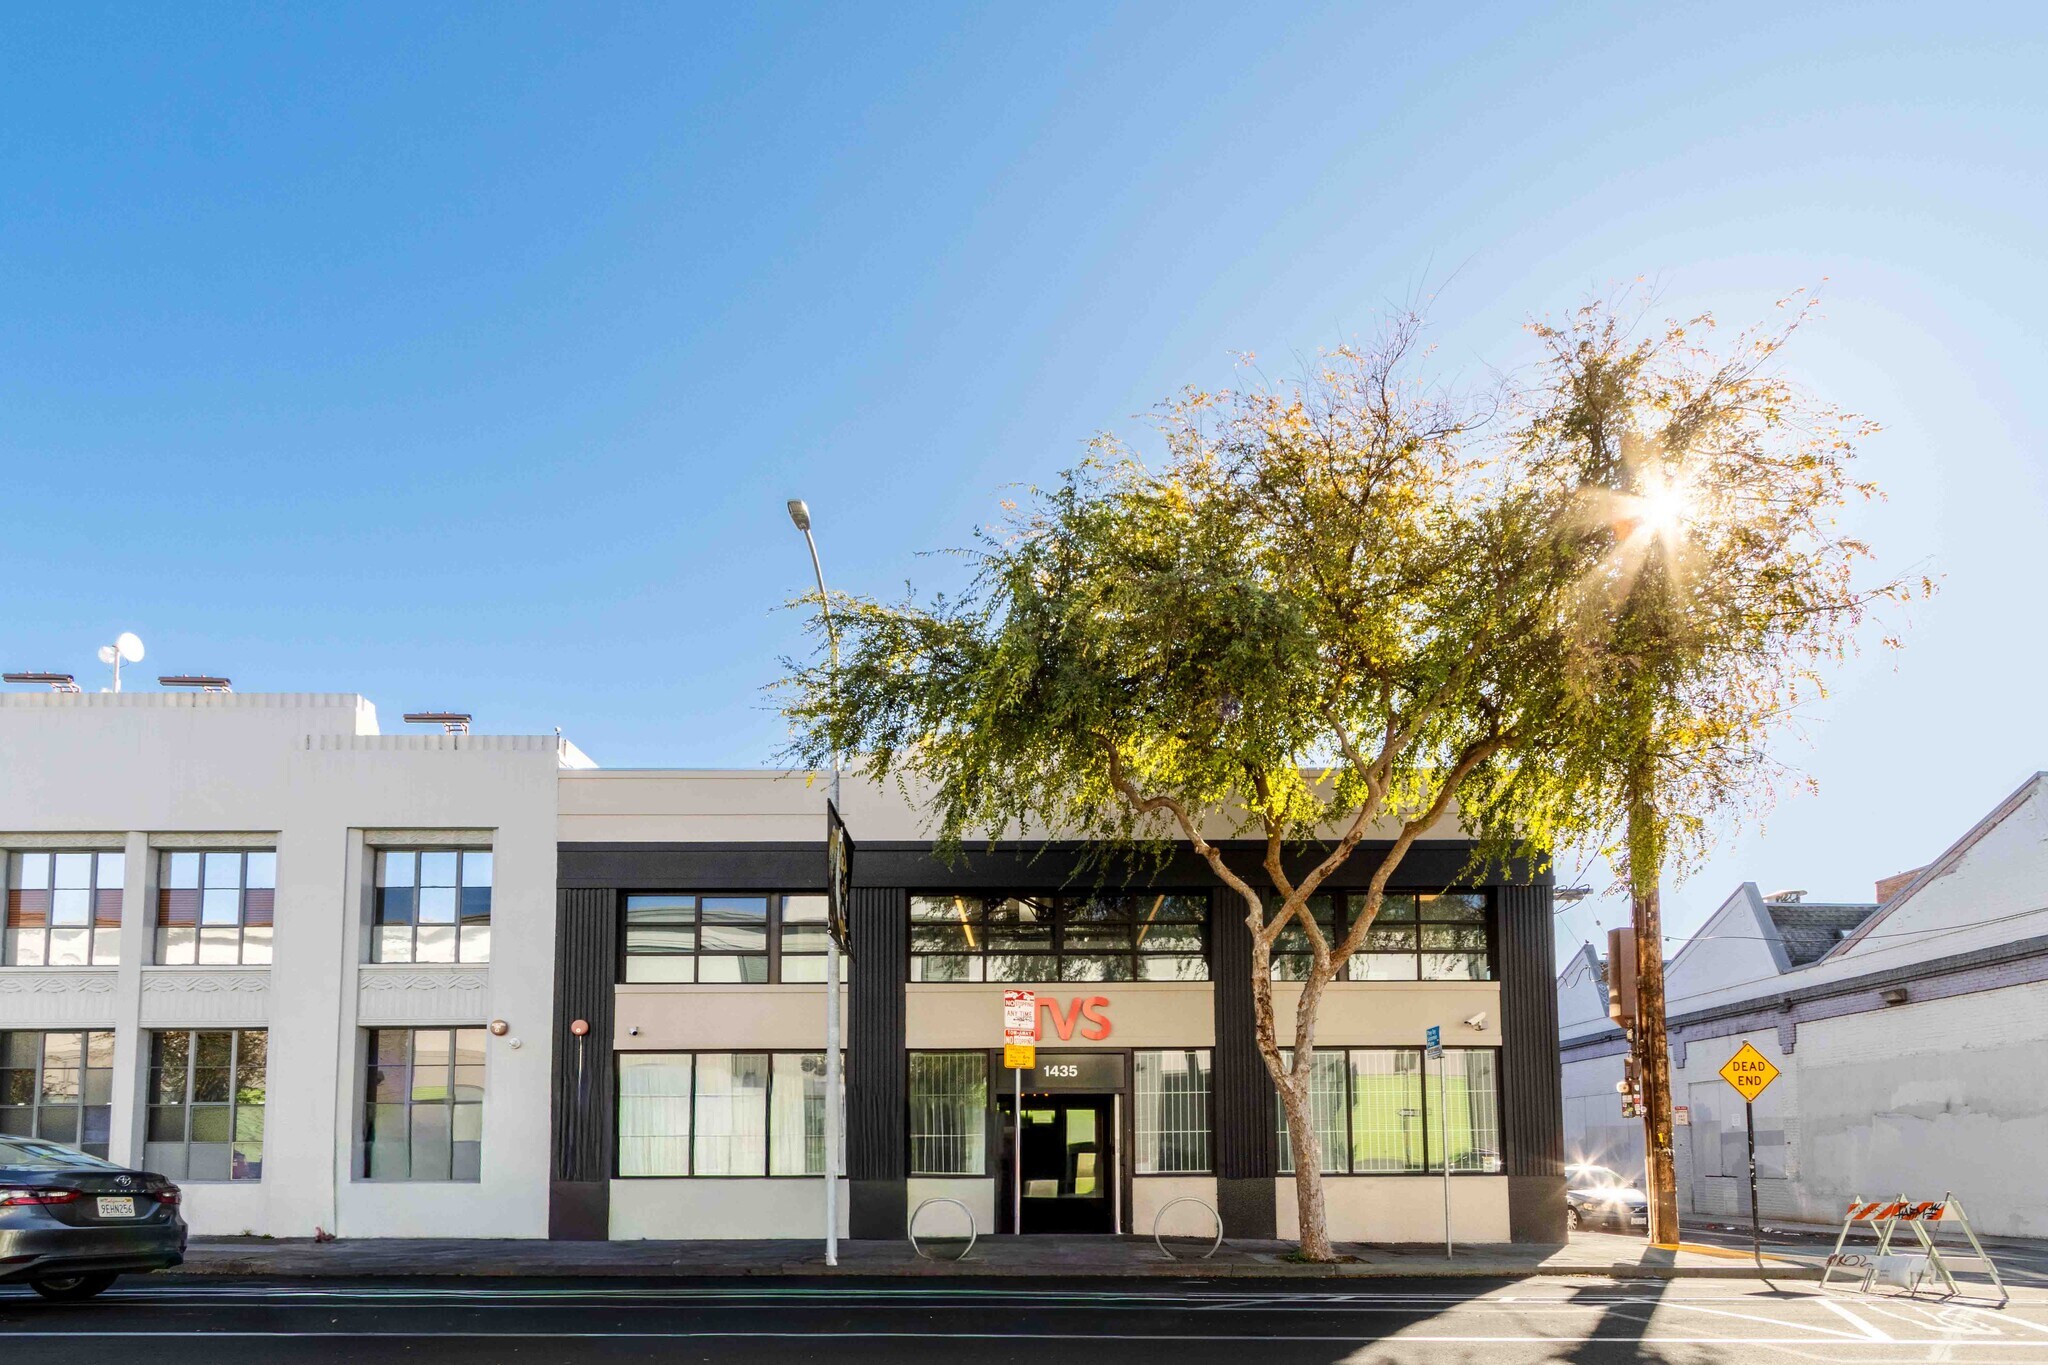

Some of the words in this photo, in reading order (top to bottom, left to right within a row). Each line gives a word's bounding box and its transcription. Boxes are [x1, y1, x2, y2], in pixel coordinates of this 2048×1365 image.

[1043, 1065, 1078, 1077] 1435
[1732, 1061, 1766, 1072] DEAD
[1738, 1075, 1762, 1086] END
[101, 1204, 133, 1214] 9EHN256
